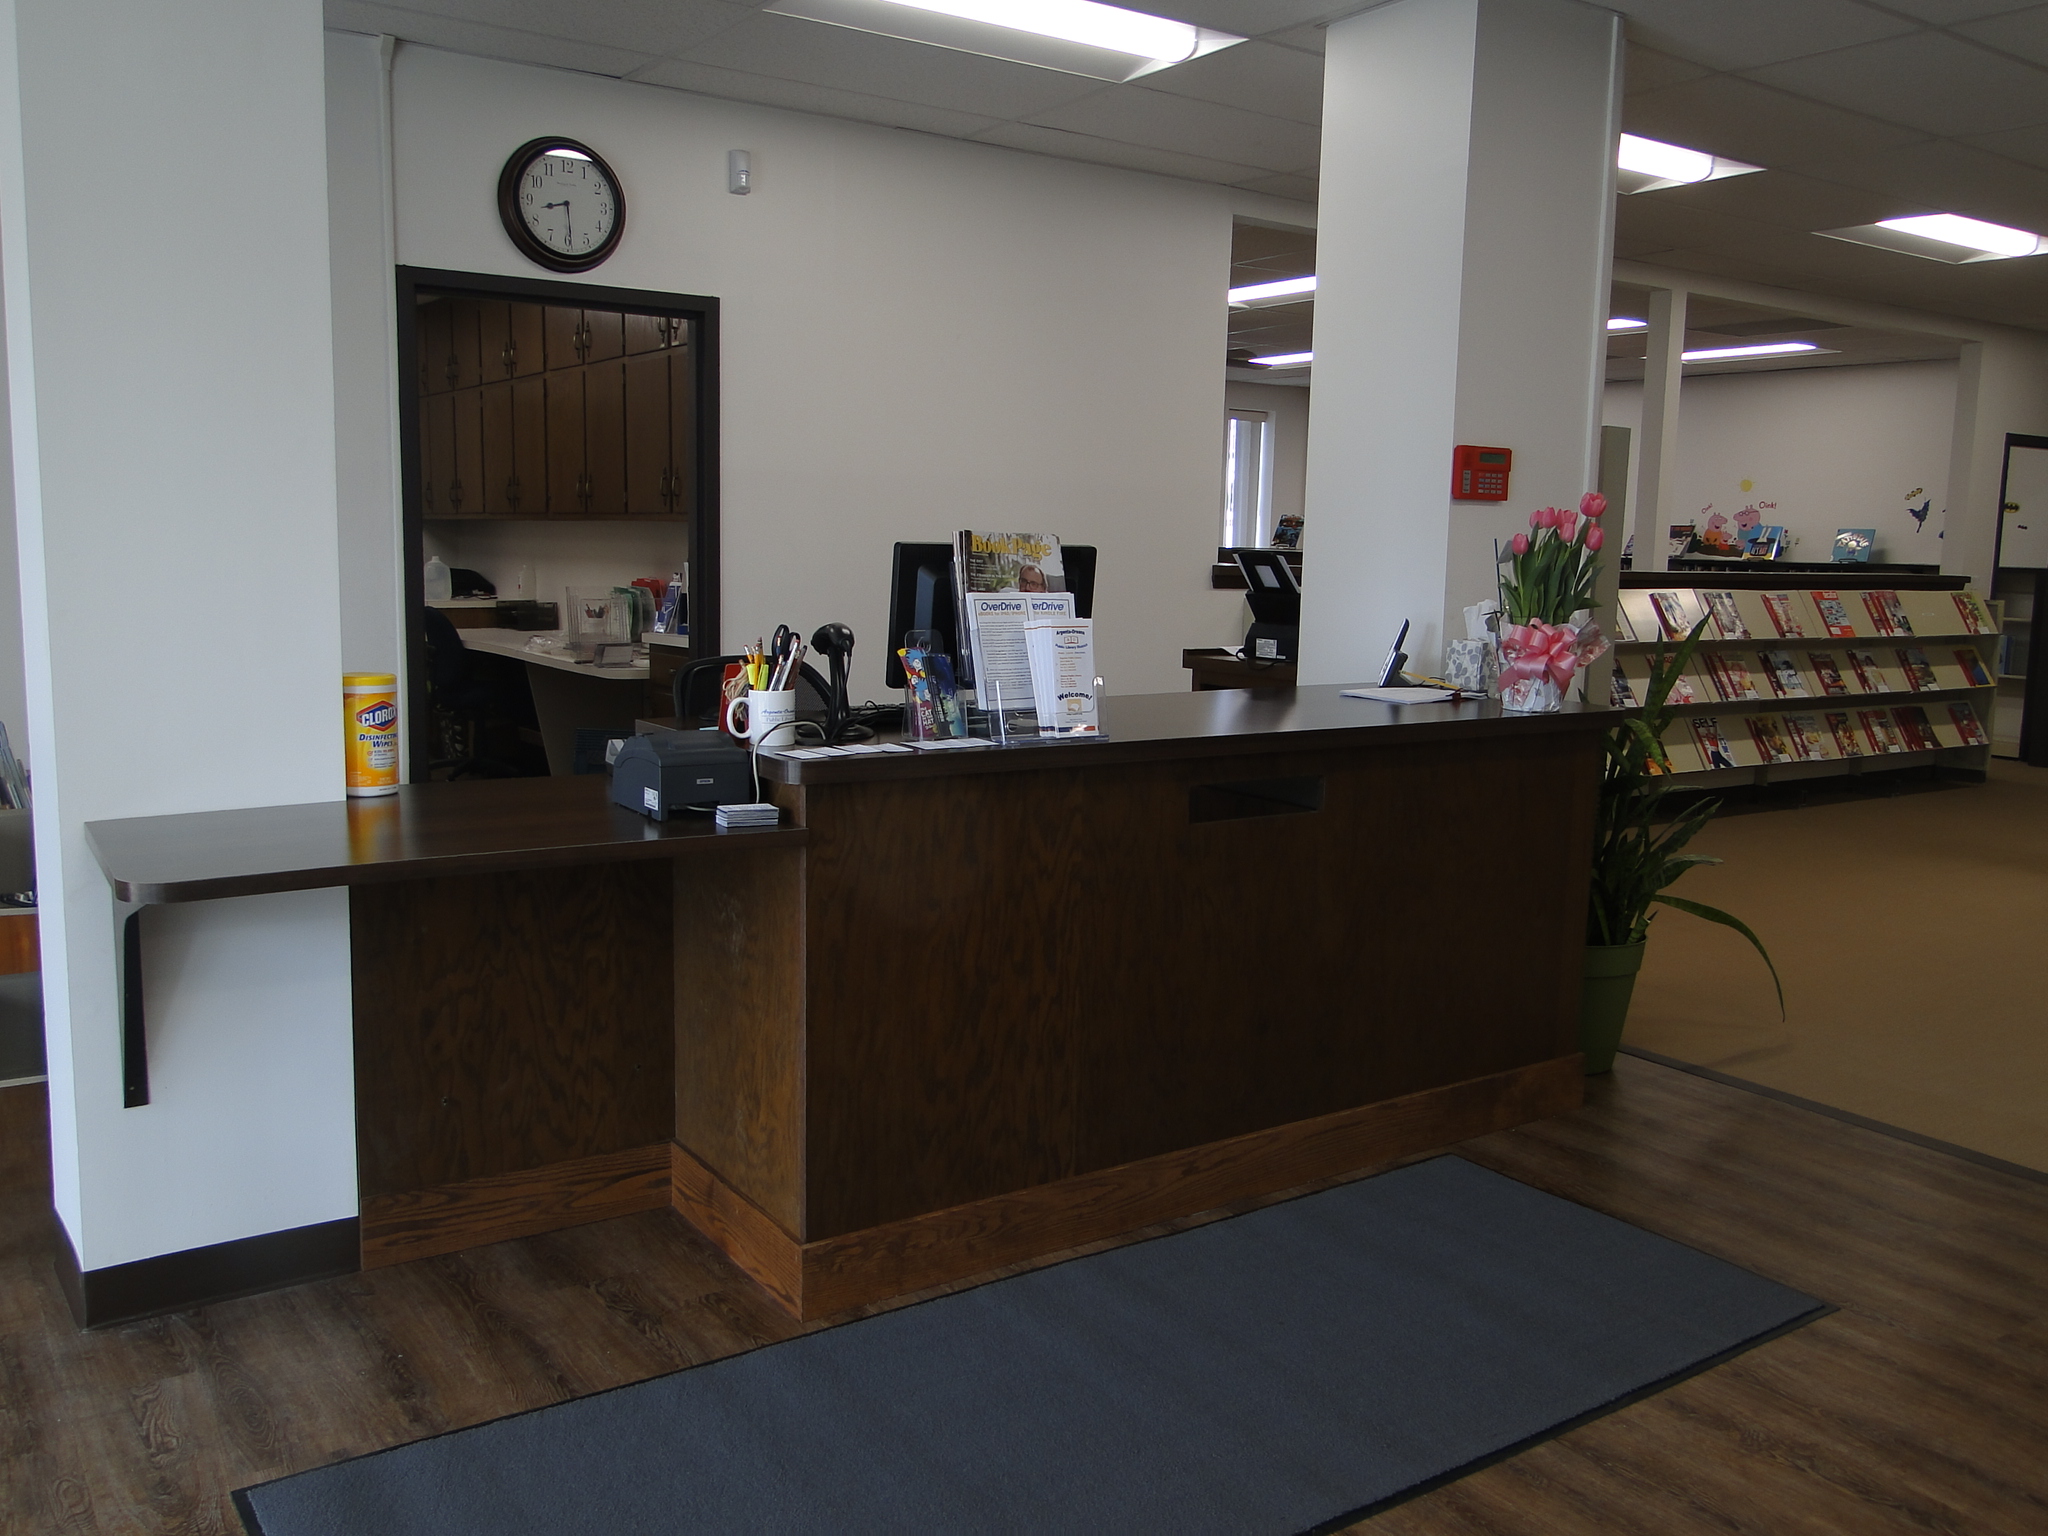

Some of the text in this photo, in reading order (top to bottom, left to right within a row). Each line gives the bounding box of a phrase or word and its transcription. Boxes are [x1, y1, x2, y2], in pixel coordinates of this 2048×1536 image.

[543, 163, 554, 177] 11
[561, 160, 574, 173] 12
[581, 166, 587, 179] 1
[531, 175, 543, 188] 10
[594, 181, 601, 195] 2
[526, 193, 533, 205] 9
[600, 202, 607, 215] 3
[532, 213, 540, 226] 8
[595, 220, 602, 233] 4
[547, 228, 554, 242] 7
[564, 234, 571, 247] 6
[583, 233, 590, 246] 5
[1758, 501, 1777, 509] Oink!
[971, 534, 1052, 561] BookPage
[981, 602, 1022, 611] OverDrive
[1032, 602, 1064, 611] erDrive
[1057, 691, 1093, 701] Welcome!
[361, 706, 397, 727] CLOROX
[1692, 717, 1718, 728] SELF
